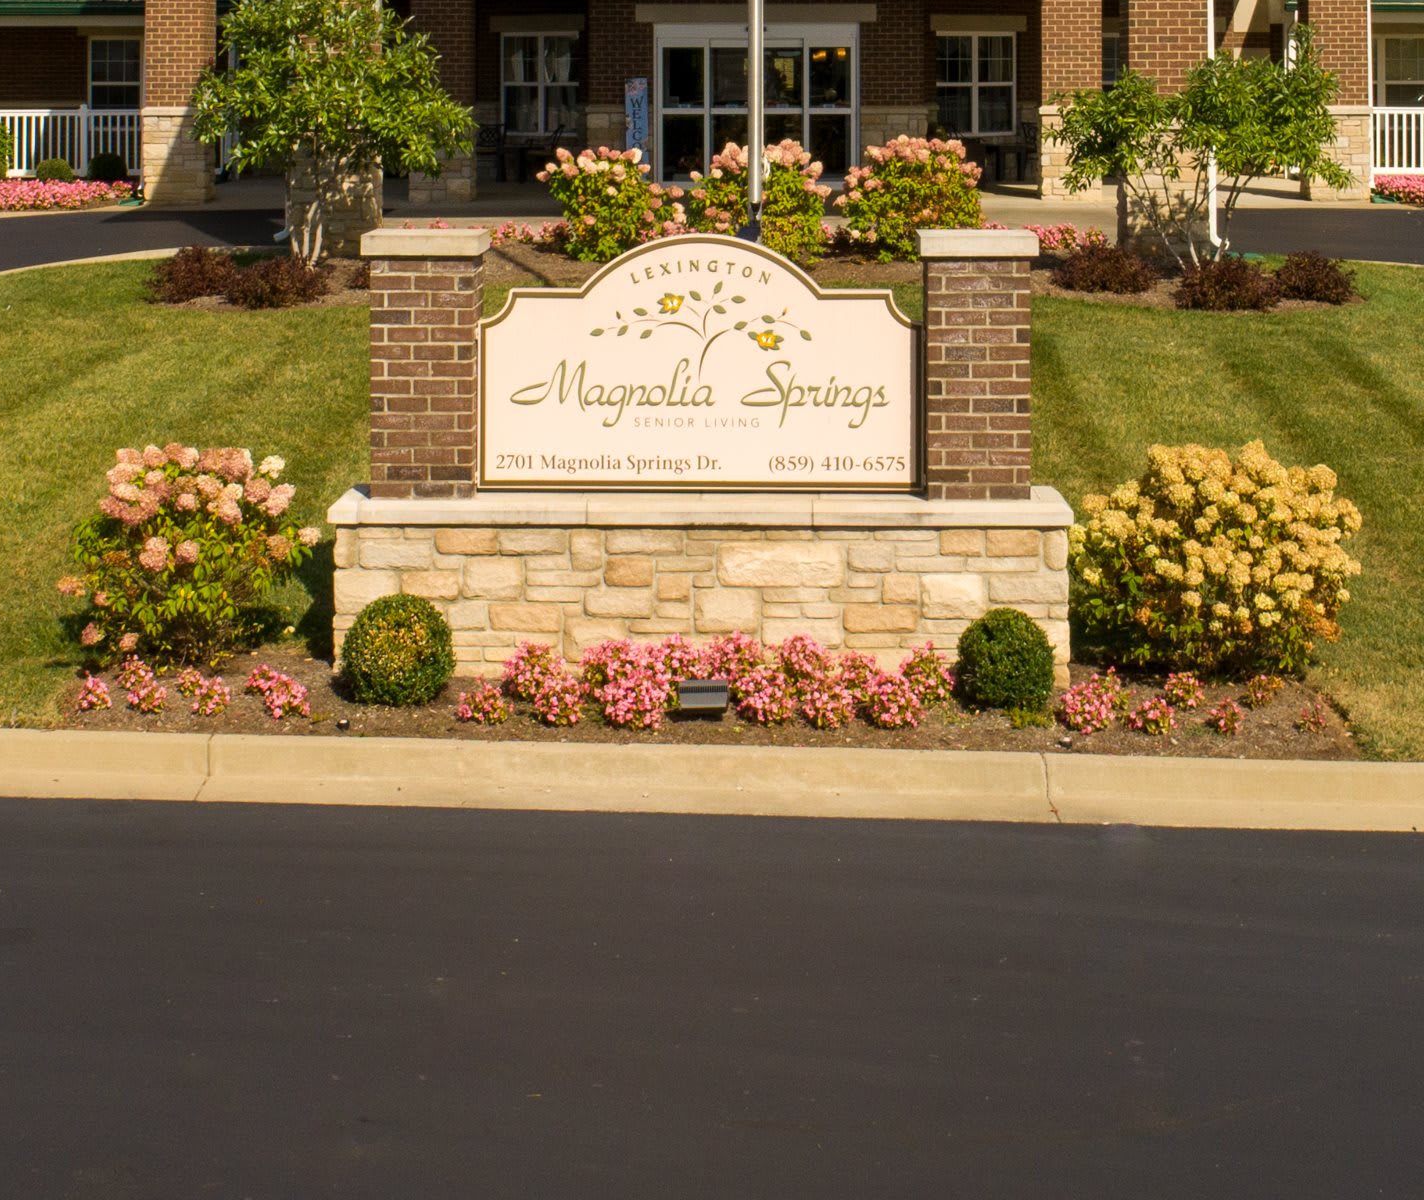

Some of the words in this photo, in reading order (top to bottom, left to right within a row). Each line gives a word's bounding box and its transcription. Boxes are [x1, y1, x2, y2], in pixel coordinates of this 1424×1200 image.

[630, 96, 644, 149] WELCO
[629, 259, 773, 286] LEXINGTON
[510, 358, 716, 428] Magnolia
[740, 360, 891, 429] Springs
[633, 417, 696, 429] SENIOR
[704, 417, 760, 429] LIVING
[495, 454, 533, 470] 2701
[541, 454, 621, 474] Magnolia
[626, 454, 691, 474] Springs
[697, 455, 722, 470] Dr.
[768, 455, 815, 473] (859)
[821, 455, 906, 471] 410-6575
